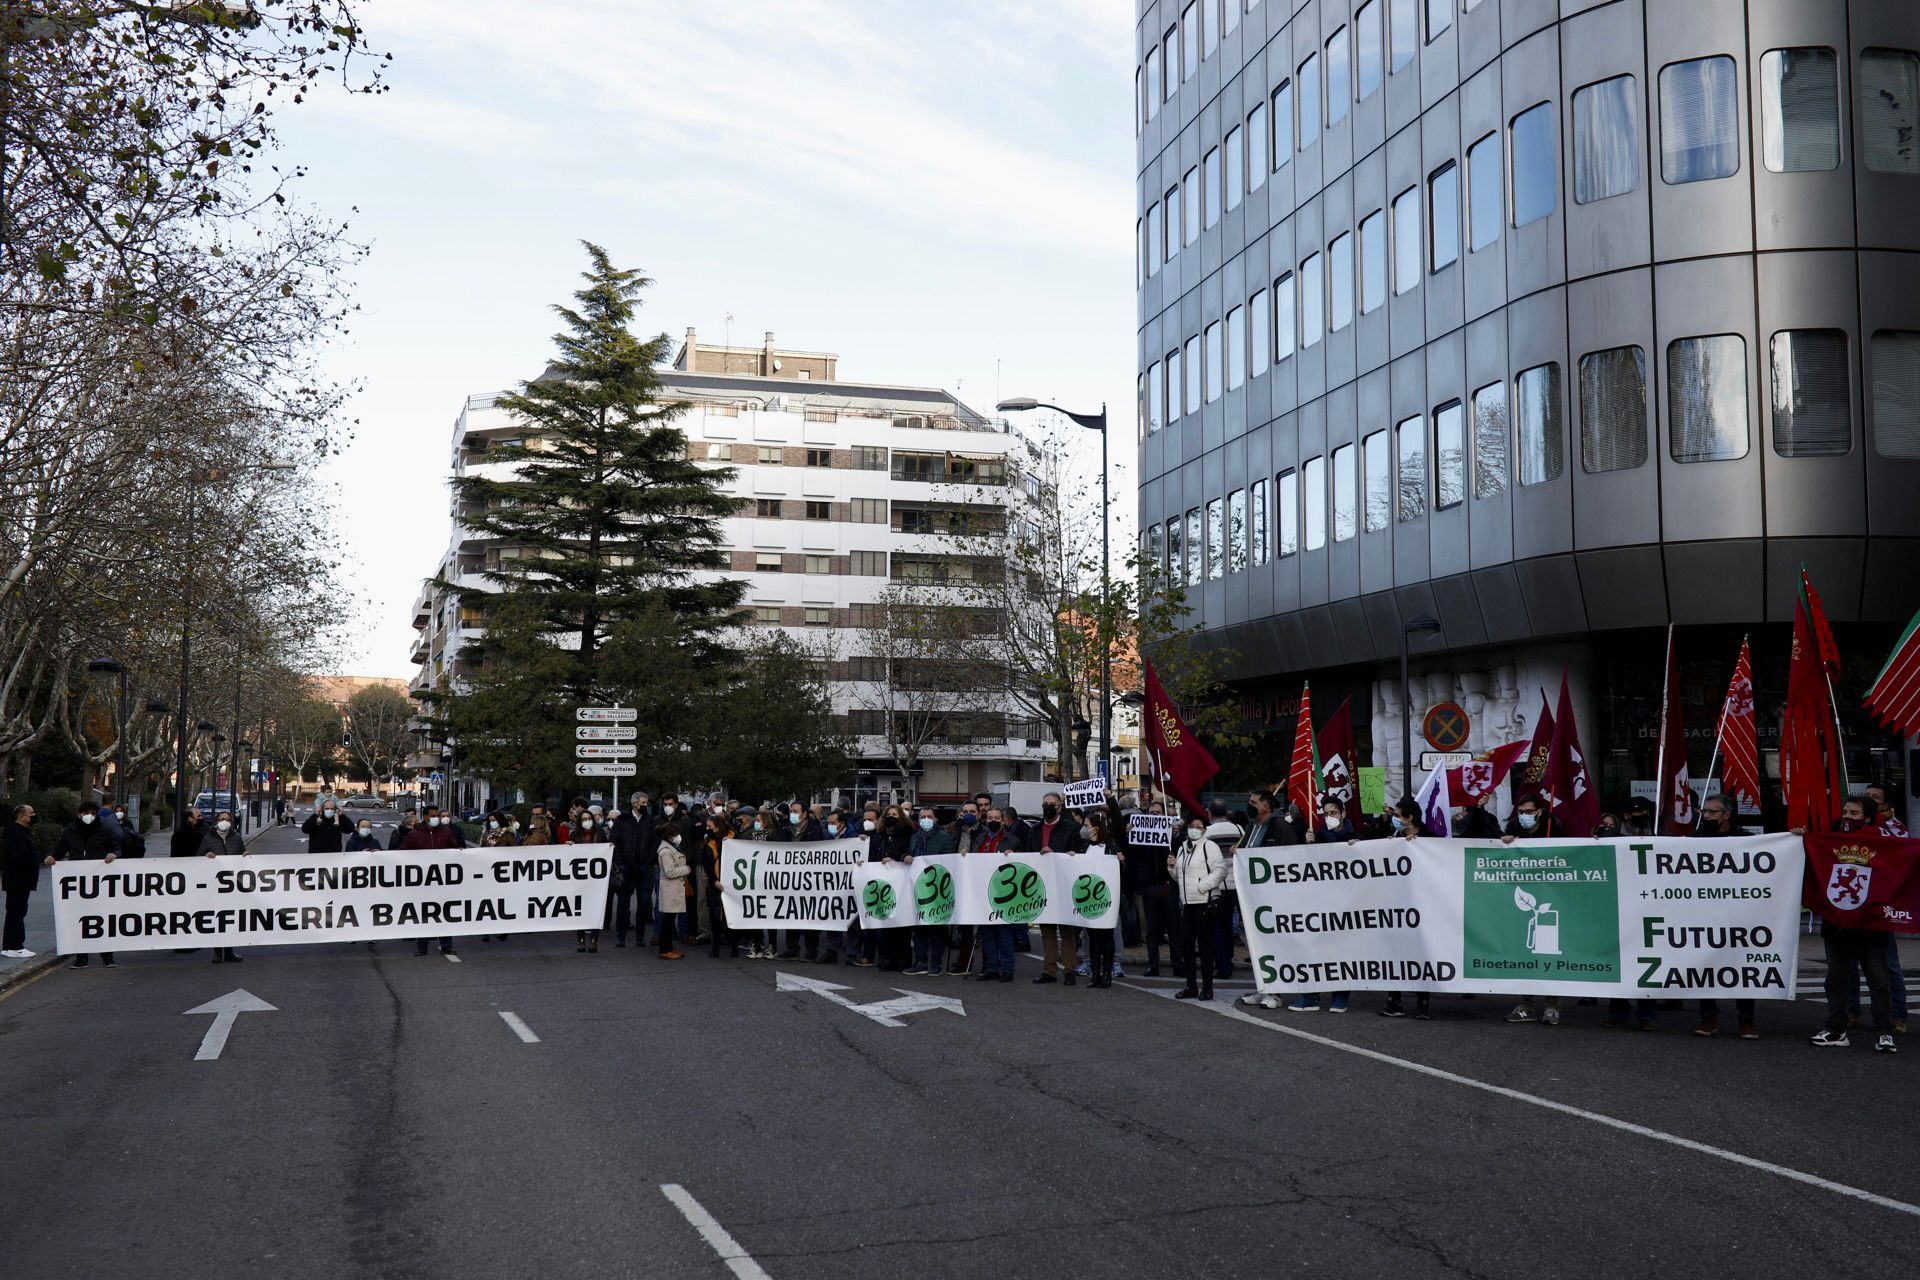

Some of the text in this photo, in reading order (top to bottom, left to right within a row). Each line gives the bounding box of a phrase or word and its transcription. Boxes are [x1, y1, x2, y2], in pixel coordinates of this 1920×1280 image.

[1066, 778, 1104, 792] CORRUPTOS
[1066, 792, 1104, 806] FUERA
[1130, 831, 1169, 844] FUERA
[732, 850, 760, 890] SÍ
[766, 850, 861, 865] AL DESARROLLO
[1248, 856, 1412, 884] DESARROLLO
[1476, 856, 1567, 868] Biorrefinería
[1630, 844, 1776, 875] TRABAJO
[60, 871, 187, 900] FUTURO
[216, 864, 464, 893] SOSTENIBILIDAD
[491, 856, 608, 884] EMPLEO
[764, 871, 854, 890] INDUSTRIAL
[918, 865, 952, 906] 3e
[994, 863, 1038, 904] 3e
[1076, 874, 1106, 904] 3e
[1474, 870, 1607, 881] Multifuncional YA!
[866, 880, 891, 907] 3e
[1073, 899, 1112, 915] en acción
[1640, 887, 1772, 900] +1.000 EMPLEOS
[79, 894, 583, 939] BIORREFINERÍA BARCIAL ¡YA!
[742, 895, 858, 920] DE ZAMORA
[988, 895, 1048, 922] en acción
[1254, 906, 1421, 934] CRECIMIENTO
[1890, 910, 1913, 920] UPL
[1642, 916, 1773, 949] FUTURO
[1258, 955, 1456, 984] SOSTENIBILIDAD
[1472, 958, 1612, 972] Bioetanol y Piensos
[1746, 954, 1782, 963] PARA
[1637, 957, 1786, 988] ZAMORA
